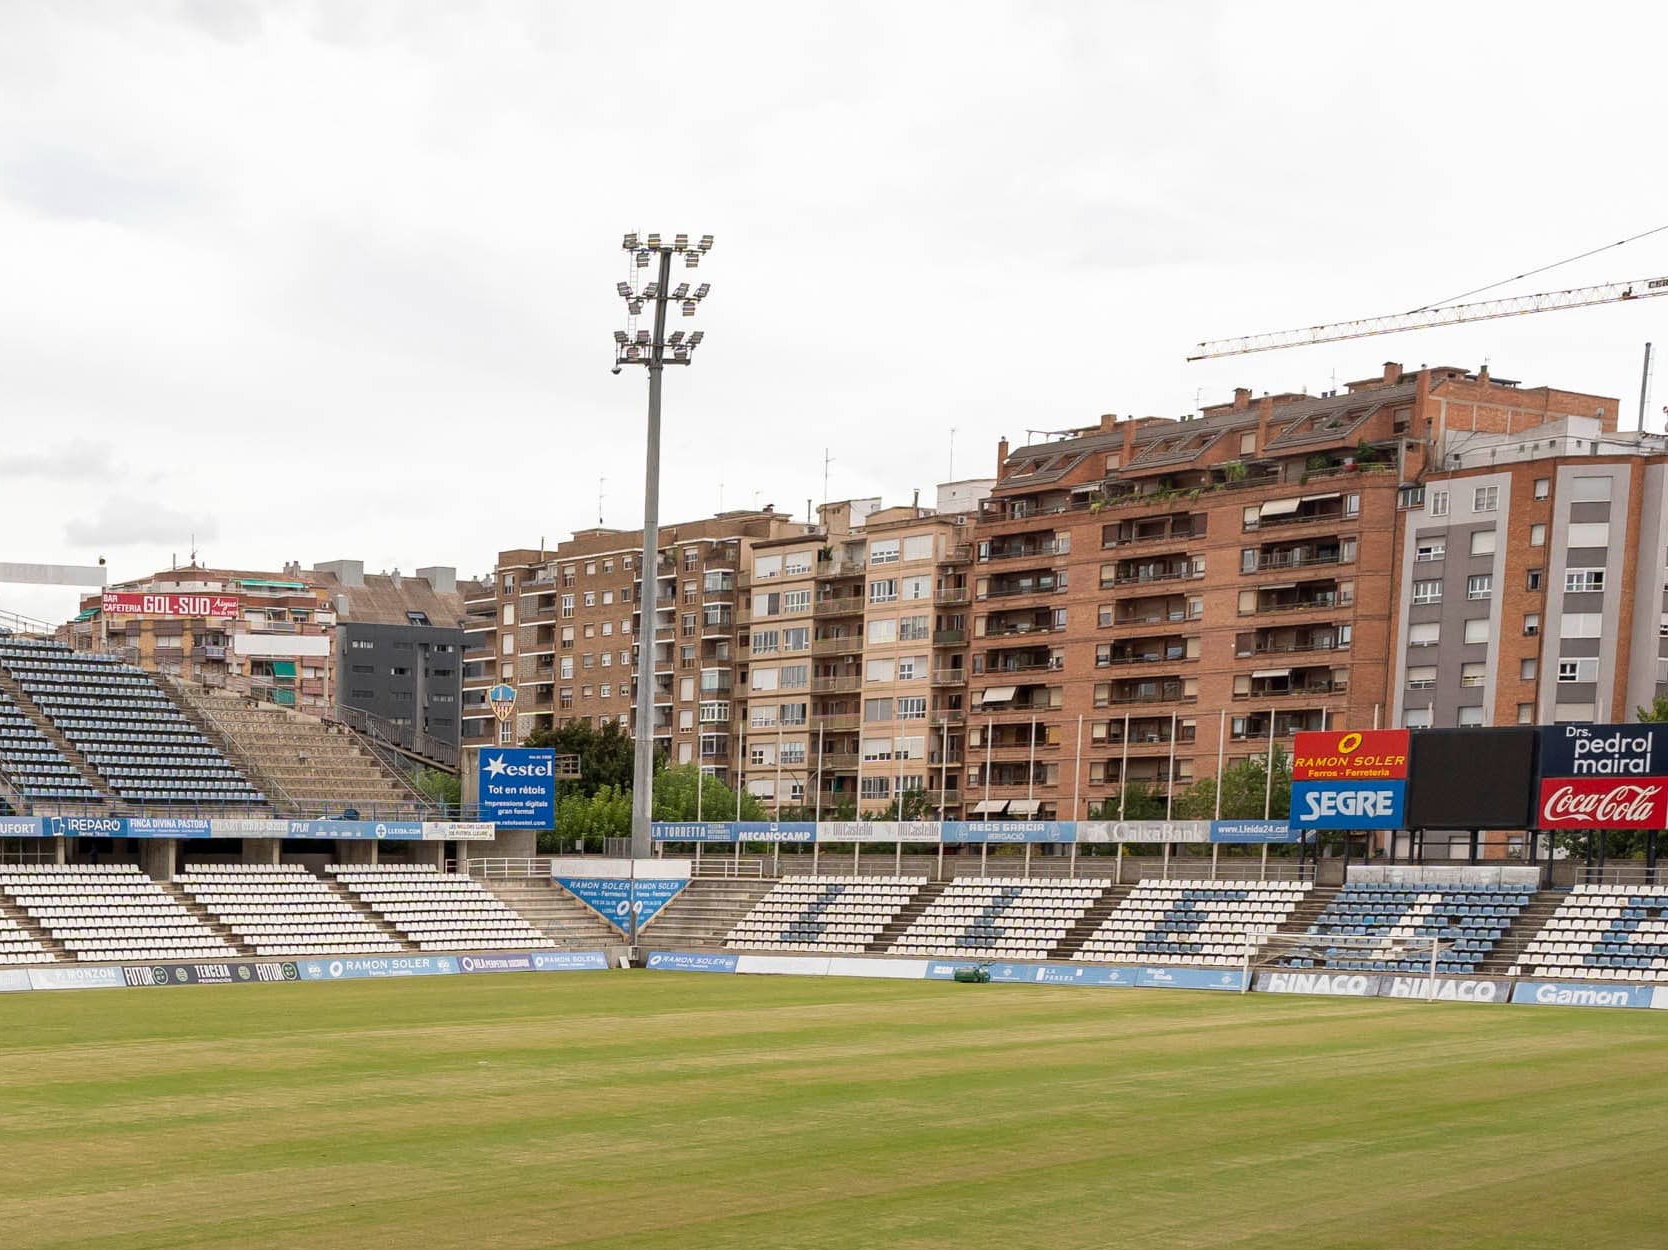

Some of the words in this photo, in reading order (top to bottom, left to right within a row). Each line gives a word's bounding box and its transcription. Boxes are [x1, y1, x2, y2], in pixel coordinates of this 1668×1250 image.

[103, 594, 118, 603] BAR
[143, 595, 211, 616] GOL-SUD
[1565, 726, 1592, 737] Drs.
[1574, 732, 1653, 758] pedrol
[1294, 757, 1349, 768] RAMON
[1354, 755, 1405, 766] SOLER
[1573, 753, 1651, 775] mairal
[506, 760, 553, 776] estel
[1308, 769, 1338, 778] Ferros
[1345, 768, 1389, 777] Ferreteria
[488, 785, 503, 794] Tot
[505, 786, 517, 794] en
[1299, 790, 1395, 821] SEGRE
[1543, 785, 1664, 822] Coca-Cola
[130, 819, 152, 828] FINCA
[153, 819, 177, 829] DIVINA
[178, 819, 209, 829] PASTORA
[651, 826, 660, 838] LA
[664, 826, 706, 837] TORRETTA
[738, 831, 811, 841] MECANOCAMP
[569, 881, 600, 889] RAMON
[602, 881, 631, 890] SOLER
[658, 881, 679, 889] SOLER
[346, 960, 388, 971] RAMON
[392, 959, 430, 969] SOLER
[662, 956, 693, 964] RAMON
[696, 957, 724, 965] SOLER
[124, 967, 155, 986] FUTUR
[194, 965, 231, 977] TERCERA
[255, 963, 283, 981] FUTUR
